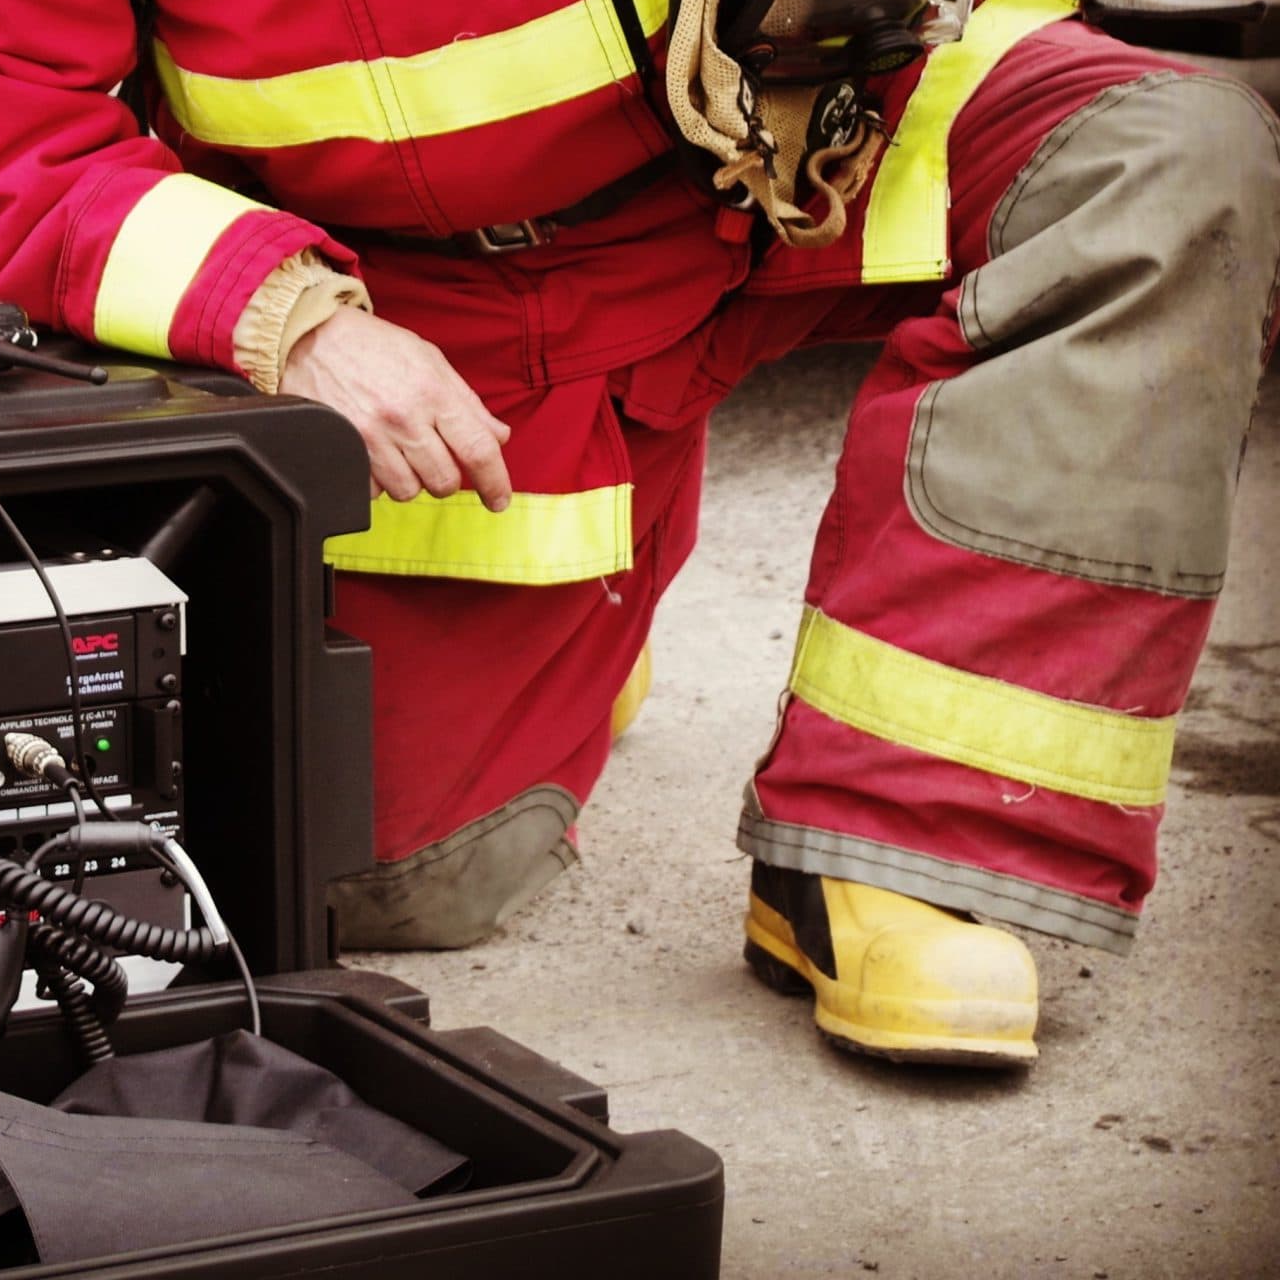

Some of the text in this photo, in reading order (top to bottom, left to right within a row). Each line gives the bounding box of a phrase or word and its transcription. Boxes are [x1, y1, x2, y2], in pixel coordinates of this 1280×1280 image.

[72, 631, 118, 653] APC
[66, 669, 124, 687] SrgeArrest
[68, 680, 123, 696] ckmount
[54, 864, 70, 876] 22
[111, 856, 126, 868] 24
